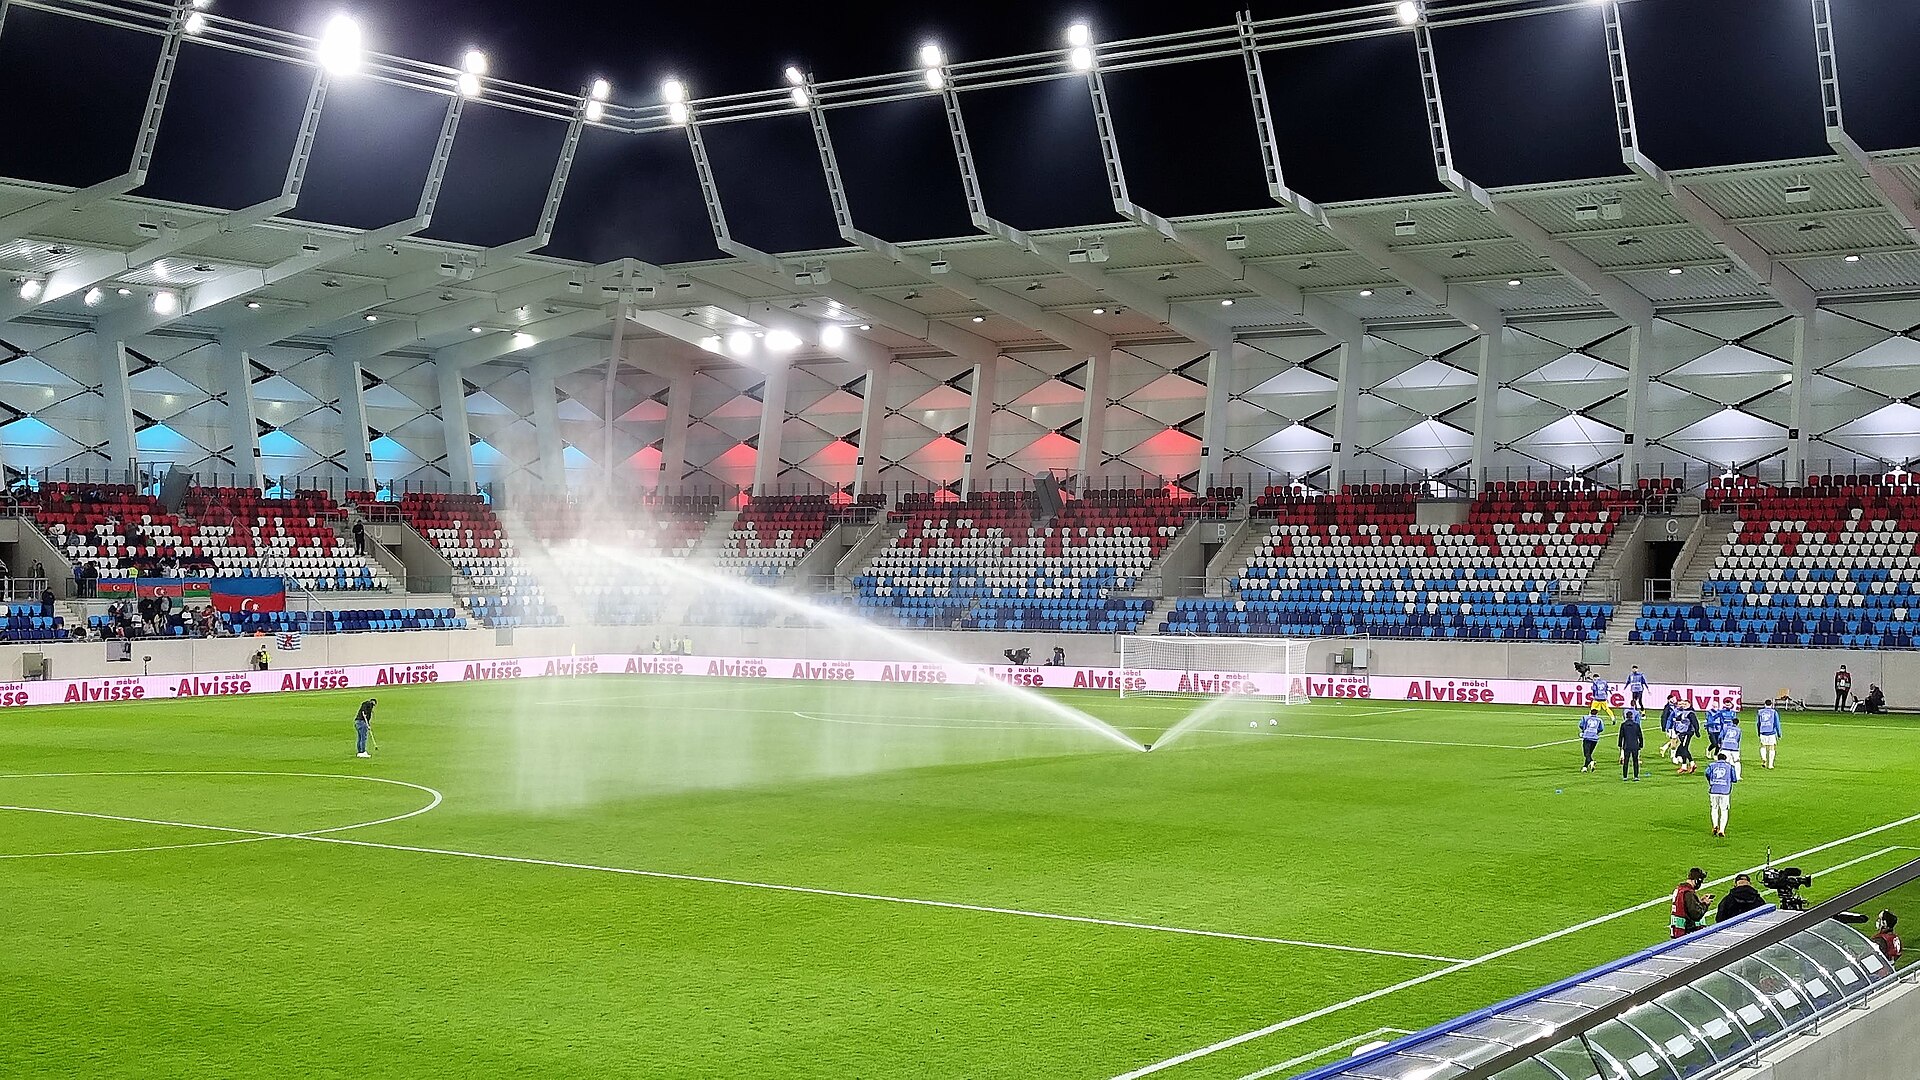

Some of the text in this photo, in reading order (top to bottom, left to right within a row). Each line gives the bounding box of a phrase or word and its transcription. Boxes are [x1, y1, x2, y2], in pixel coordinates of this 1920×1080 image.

[1217, 523, 1227, 537] B
[1665, 518, 1679, 534] C
[376, 666, 439, 686] Alvisse
[463, 662, 522, 681] Alvisse
[544, 657, 598, 676] Alvisse
[625, 657, 684, 675] Alvisse
[707, 659, 767, 678] Alvisse
[792, 662, 855, 681] Alvisse
[881, 664, 947, 684] Alvisse
[177, 675, 251, 697] Alvisse
[281, 671, 349, 692] Alvisse
[1073, 670, 1146, 690] Alvisse
[1178, 673, 1257, 694] Alvisse
[1289, 676, 1371, 698] Alvisse
[1340, 676, 1366, 684] möbel
[1461, 680, 1488, 688] möbel
[64, 680, 145, 703] Alvisse
[1407, 680, 1494, 702] Alvisse
[1532, 684, 1625, 707] Alvise
